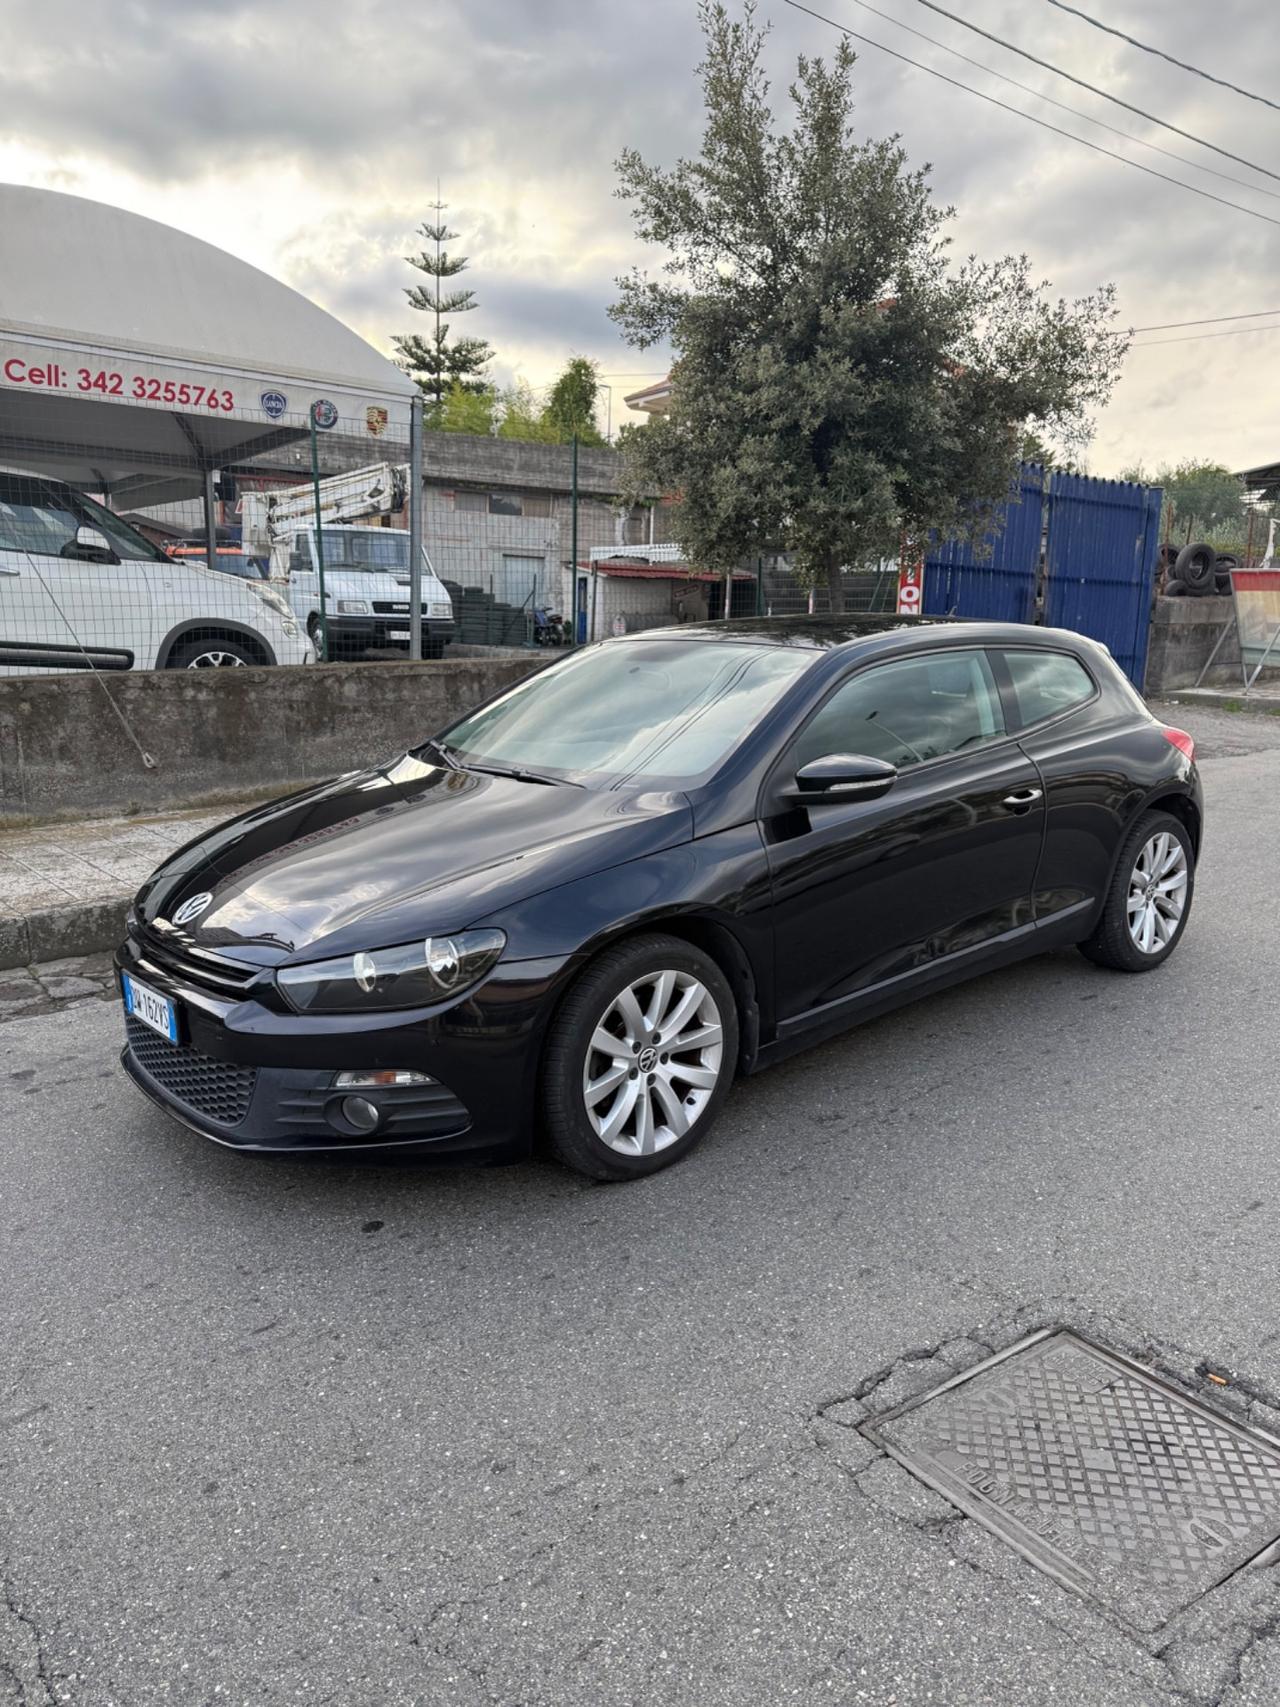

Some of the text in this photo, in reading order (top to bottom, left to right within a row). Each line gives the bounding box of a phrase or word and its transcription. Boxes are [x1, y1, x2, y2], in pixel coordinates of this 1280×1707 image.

[4, 358, 234, 411] Cell: 342 3255763
[953, 1460, 1084, 1558] FOGNAURA
